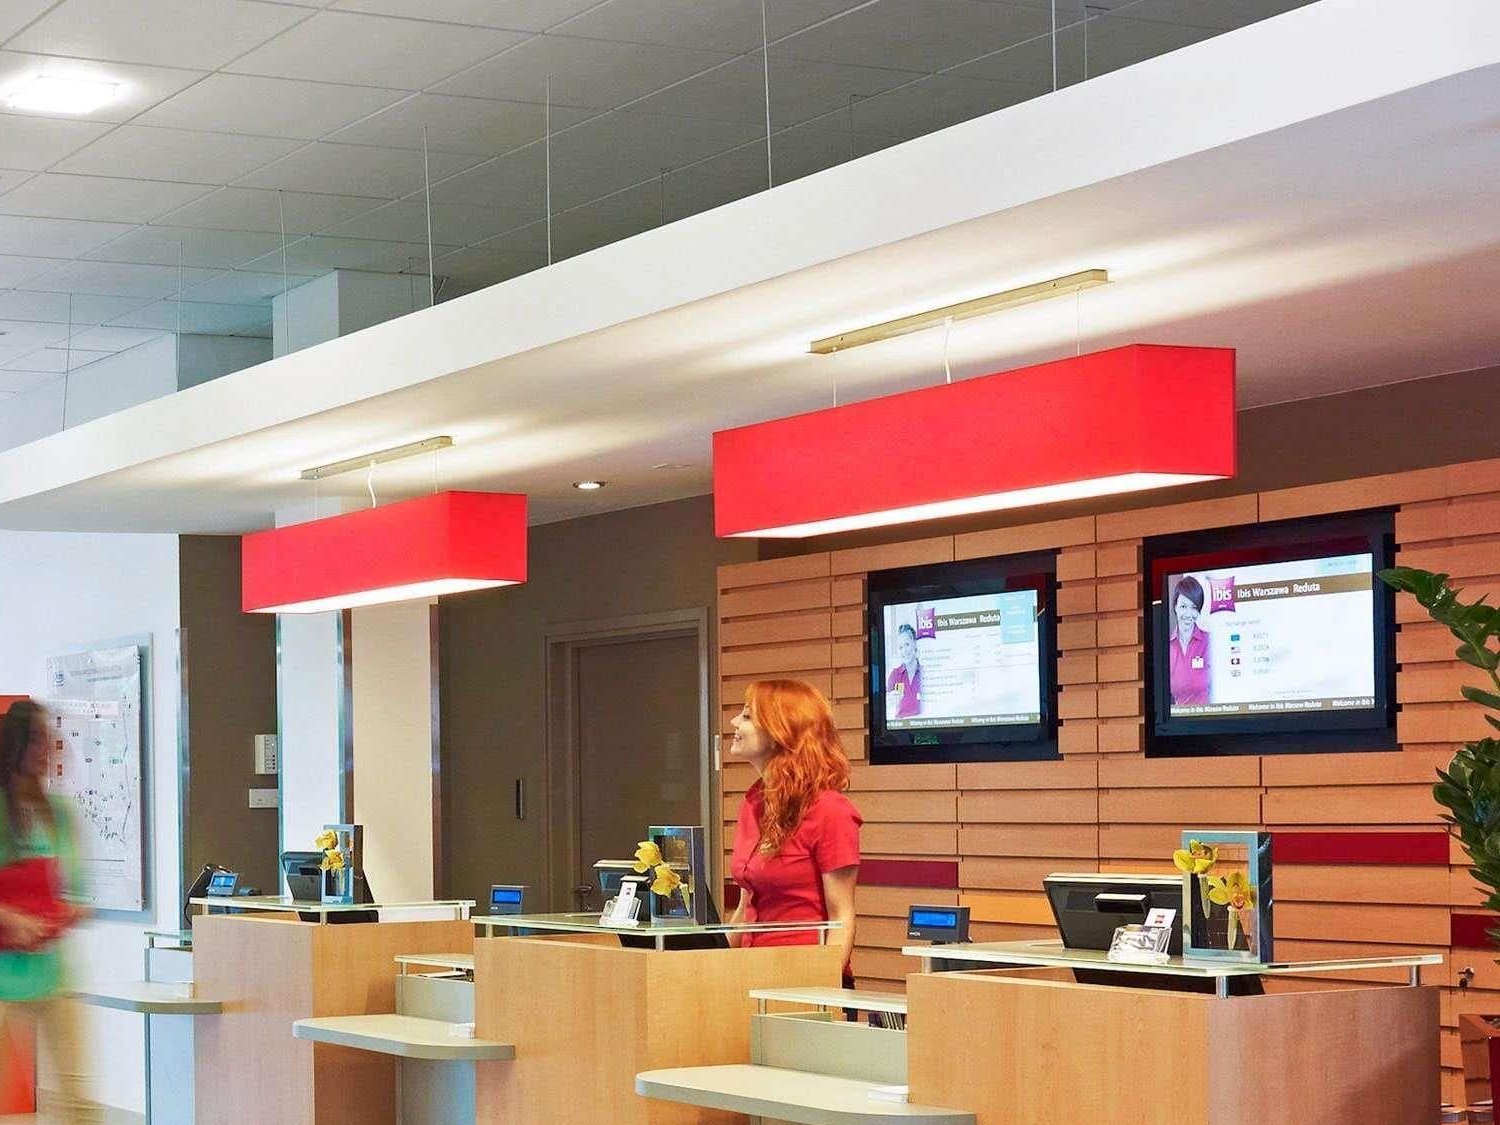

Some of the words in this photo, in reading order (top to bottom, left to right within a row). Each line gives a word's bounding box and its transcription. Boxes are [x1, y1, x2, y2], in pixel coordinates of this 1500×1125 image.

[1212, 585, 1232, 602] ibis
[1237, 589, 1251, 599] Ibis
[1252, 587, 1289, 597] Warszawa
[1293, 582, 1320, 593] Reduta
[918, 615, 933, 630] ibis
